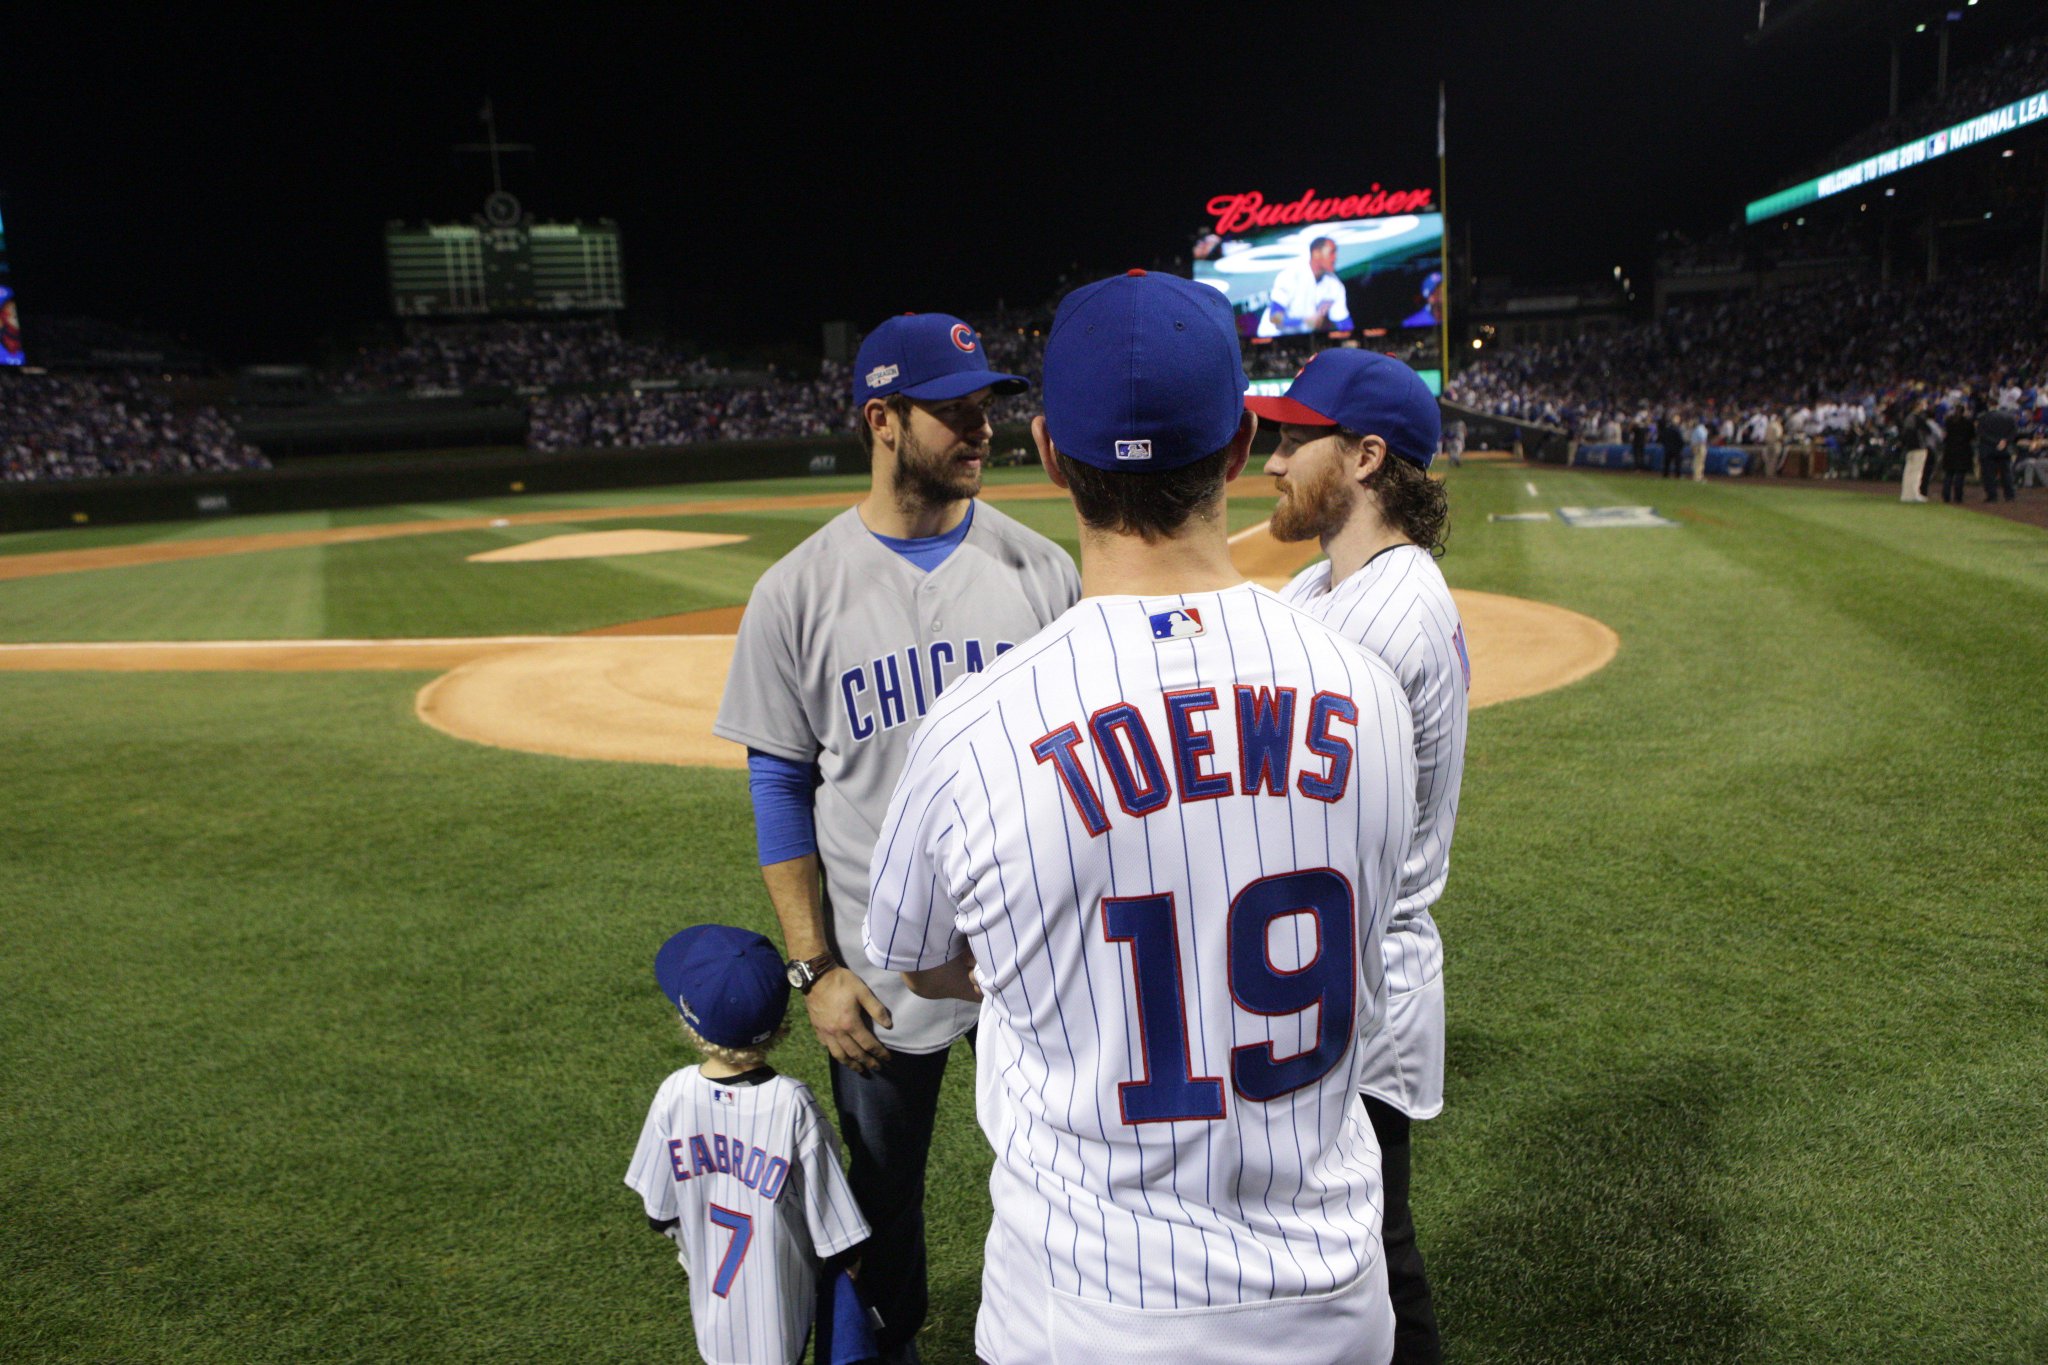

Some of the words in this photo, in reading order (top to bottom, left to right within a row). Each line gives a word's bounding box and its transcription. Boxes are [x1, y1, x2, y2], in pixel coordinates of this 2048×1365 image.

[1817, 162, 1862, 199] WELCOME
[1864, 159, 1877, 182] TO
[1878, 149, 1899, 176] THE
[1899, 141, 1926, 169] 2016
[1949, 107, 2016, 151] NATIONAL
[1206, 183, 1432, 235] Budweiser
[841, 639, 1016, 742] CHICA
[1030, 684, 1359, 839] TOEWS
[1101, 867, 1356, 1125] 19
[709, 1202, 754, 1299] 7
